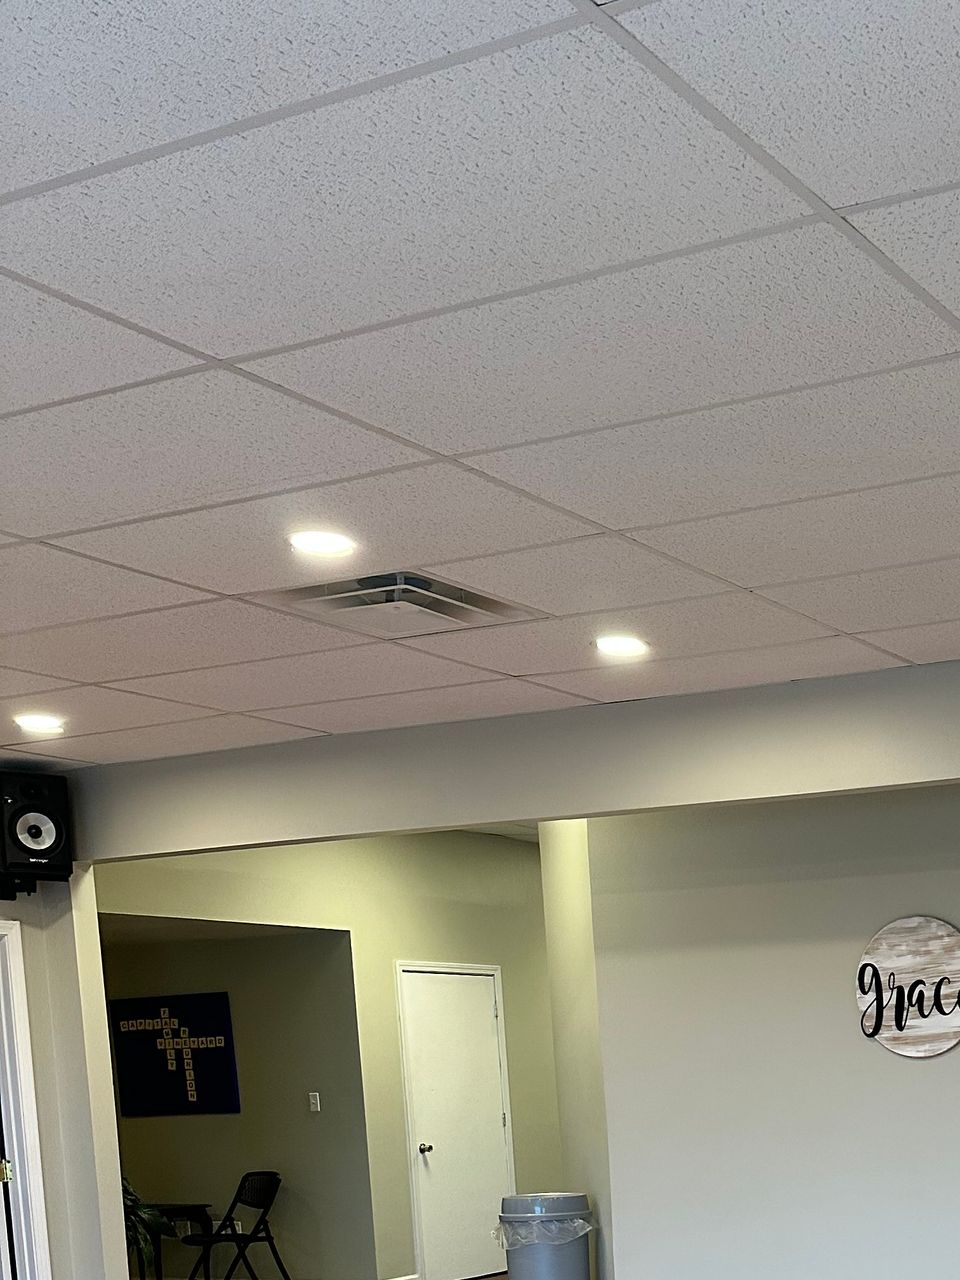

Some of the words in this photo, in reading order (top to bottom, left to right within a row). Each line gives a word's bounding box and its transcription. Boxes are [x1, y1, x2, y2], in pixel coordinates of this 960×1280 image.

[121, 1019, 178, 1030] CAPITAL
[157, 1037, 224, 1049] VINEYARD
[160, 1008, 176, 1070] FAMILY
[181, 1028, 196, 1101] REUNION
